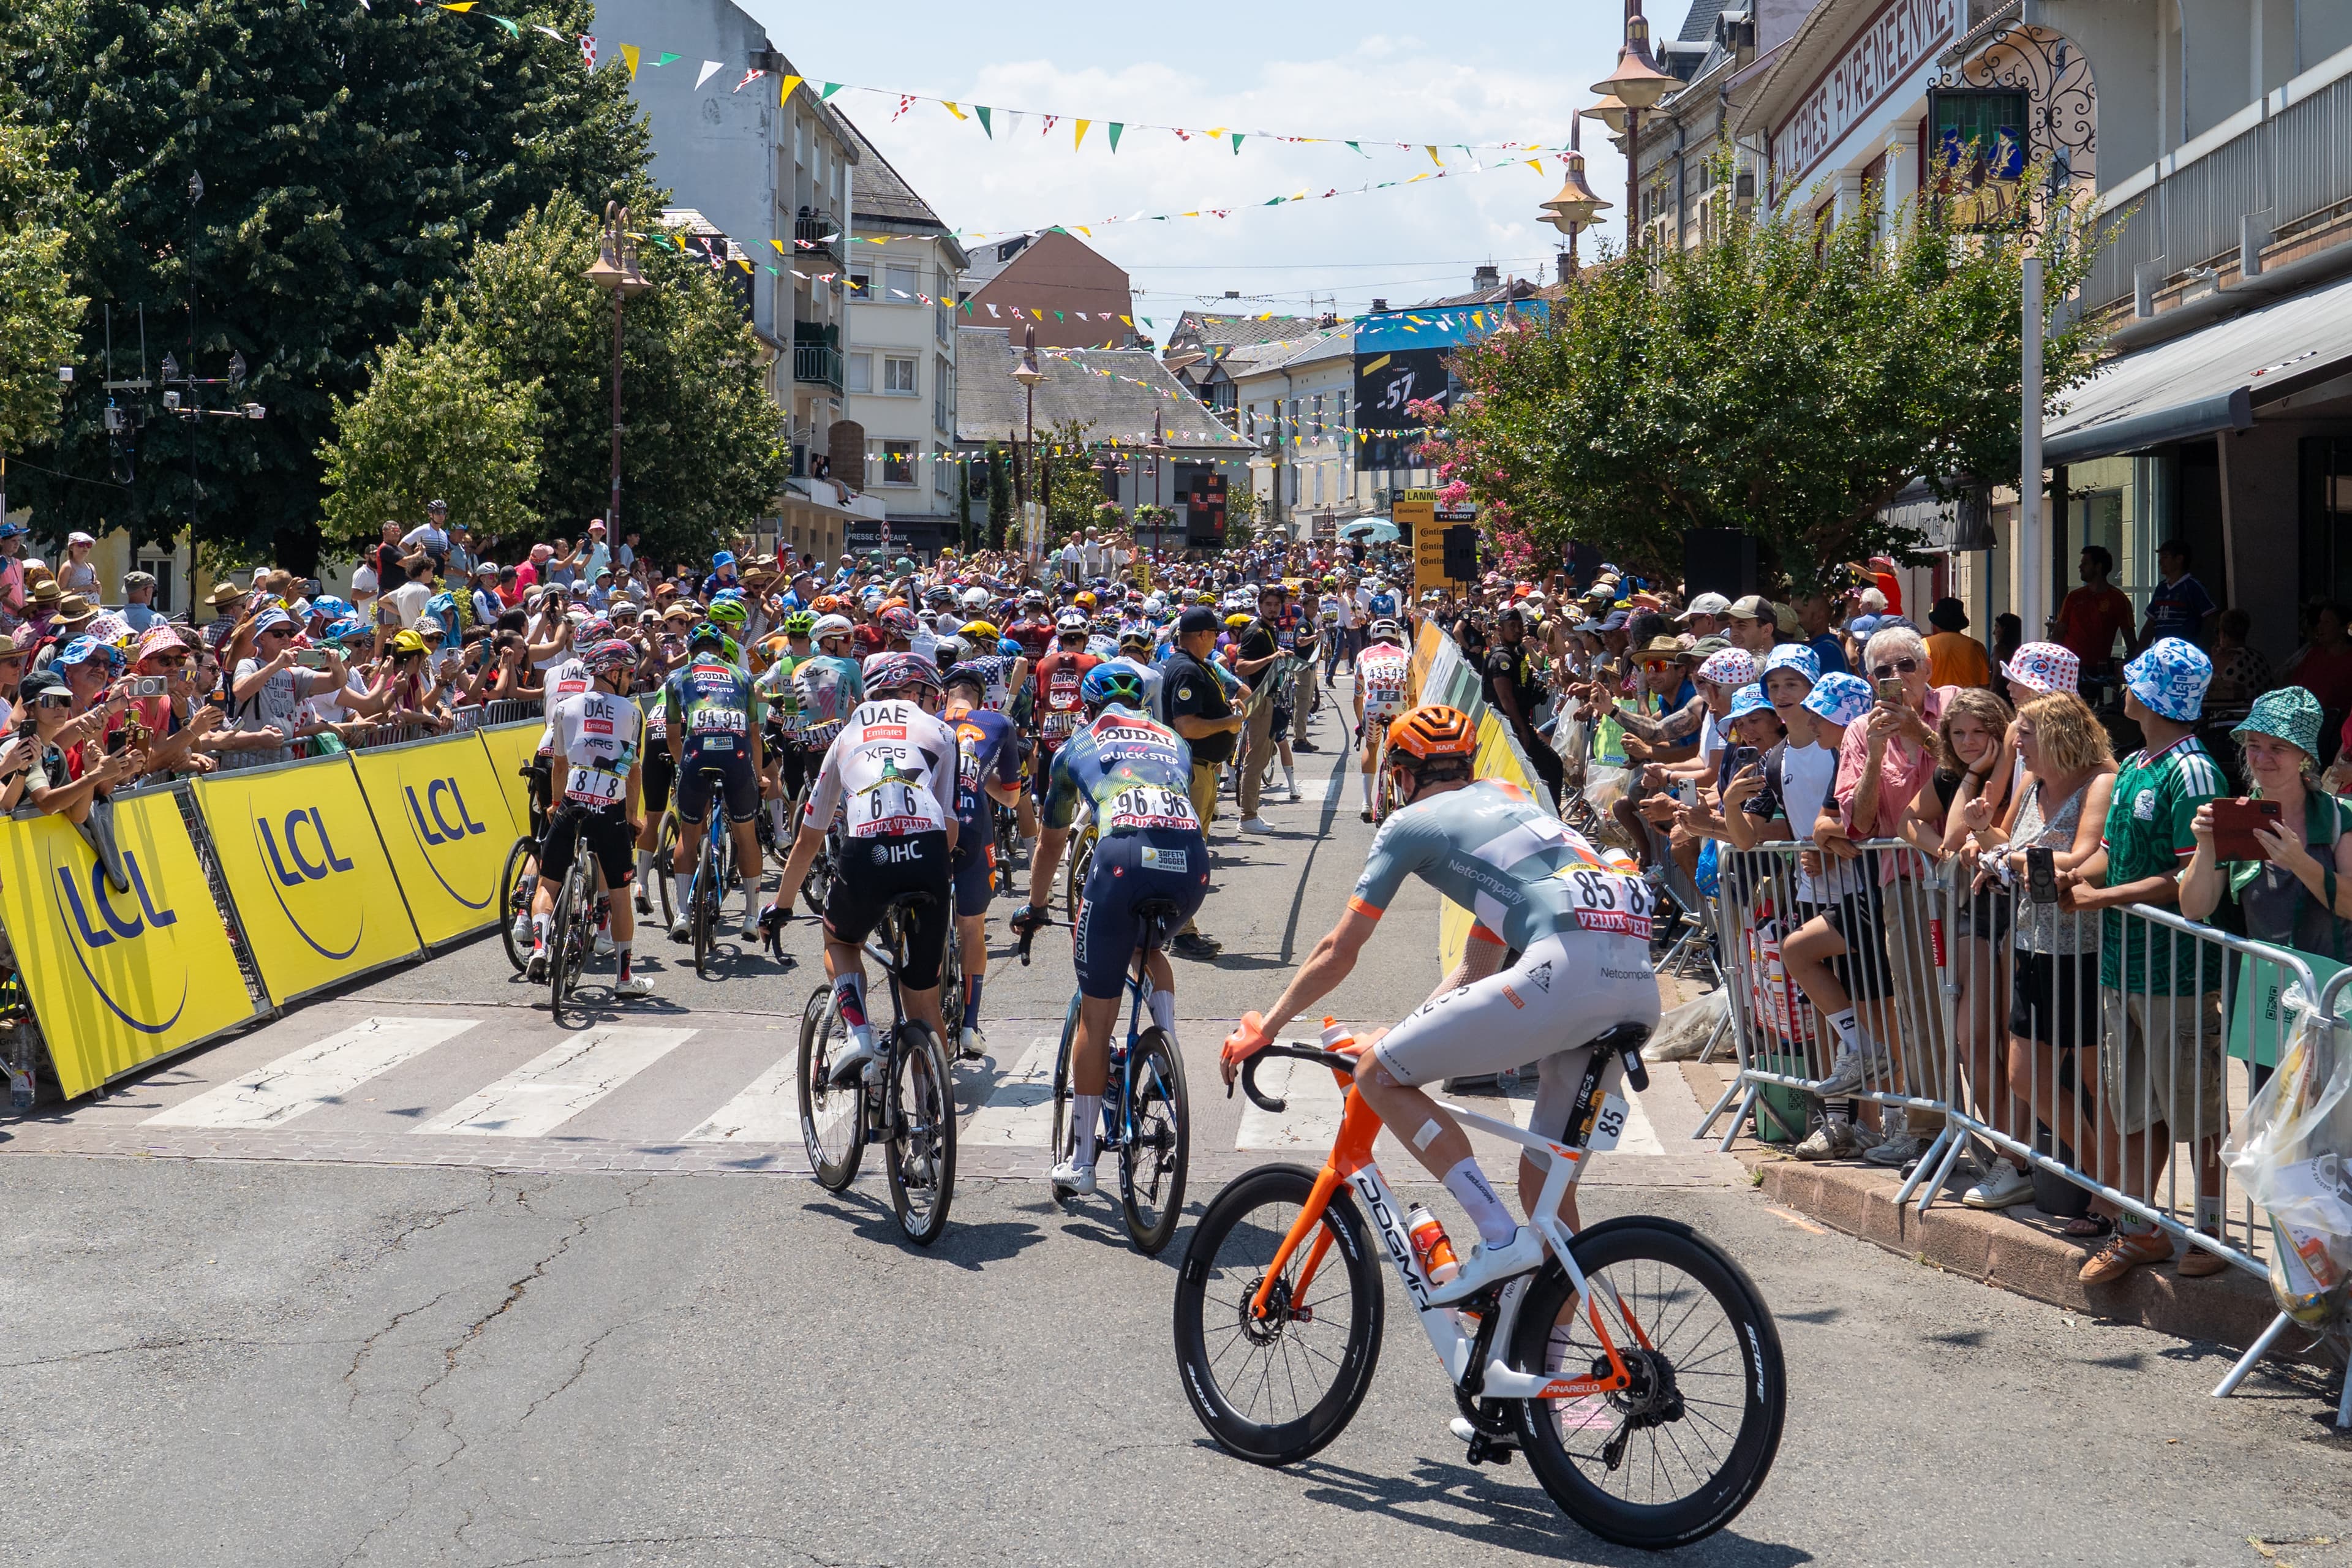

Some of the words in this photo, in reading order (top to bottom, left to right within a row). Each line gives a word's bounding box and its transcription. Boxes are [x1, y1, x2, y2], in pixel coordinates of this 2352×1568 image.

[1773, 86, 1828, 195] GALERIES
[1408, 492, 1441, 500] LANNE
[1420, 527, 1444, 537] Contin
[1420, 542, 1444, 551] Contin
[1420, 557, 1444, 567] Contin
[888, 658, 907, 668] MET
[693, 673, 732, 682] SOUDAL
[892, 668, 909, 680] G42
[1370, 667, 1382, 679] 43
[1392, 667, 1404, 680] 43
[274, 690, 287, 699] CLUB
[2175, 682, 2199, 693] Krys
[584, 703, 615, 720] UAE
[698, 710, 717, 728] 94
[723, 712, 742, 729] 94
[859, 707, 908, 726] UAE
[586, 722, 611, 731] Emirates
[866, 728, 903, 738] Emirates
[584, 737, 613, 750] XRG
[1096, 729, 1176, 748] SOUDAL
[575, 770, 586, 792] 8
[606, 777, 619, 799] 8
[404, 777, 486, 846] LCL
[871, 788, 883, 820] 6
[903, 785, 917, 816] 6
[1118, 790, 1148, 817] 96
[1161, 791, 1188, 819] 96
[858, 818, 892, 837] VELUX
[893, 818, 932, 831] VELUX
[1111, 815, 1154, 828] VELUX
[1154, 816, 1197, 830] VELUX
[257, 805, 354, 887] LCL
[890, 840, 923, 864] IHC
[1158, 850, 1185, 859] SAFETY
[1158, 857, 1185, 866] JOGGER
[1447, 859, 1528, 905] Netcompany
[1574, 871, 1616, 910] 85
[57, 850, 178, 949] LCL
[1577, 911, 1626, 930] VELUX
[1076, 900, 1091, 961] SOUDAL
[1600, 967, 1656, 982] Netcompan
[1575, 1073, 1594, 1110] INEOS
[1598, 1107, 1624, 1137] 85
[1463, 1170, 1496, 1204] Netcompany
[1326, 1206, 1359, 1262] SCOPE
[1743, 1321, 1765, 1404] SCOPE
[1186, 1361, 1218, 1419] SCOPE
[1546, 1383, 1600, 1393] PINARELLO
